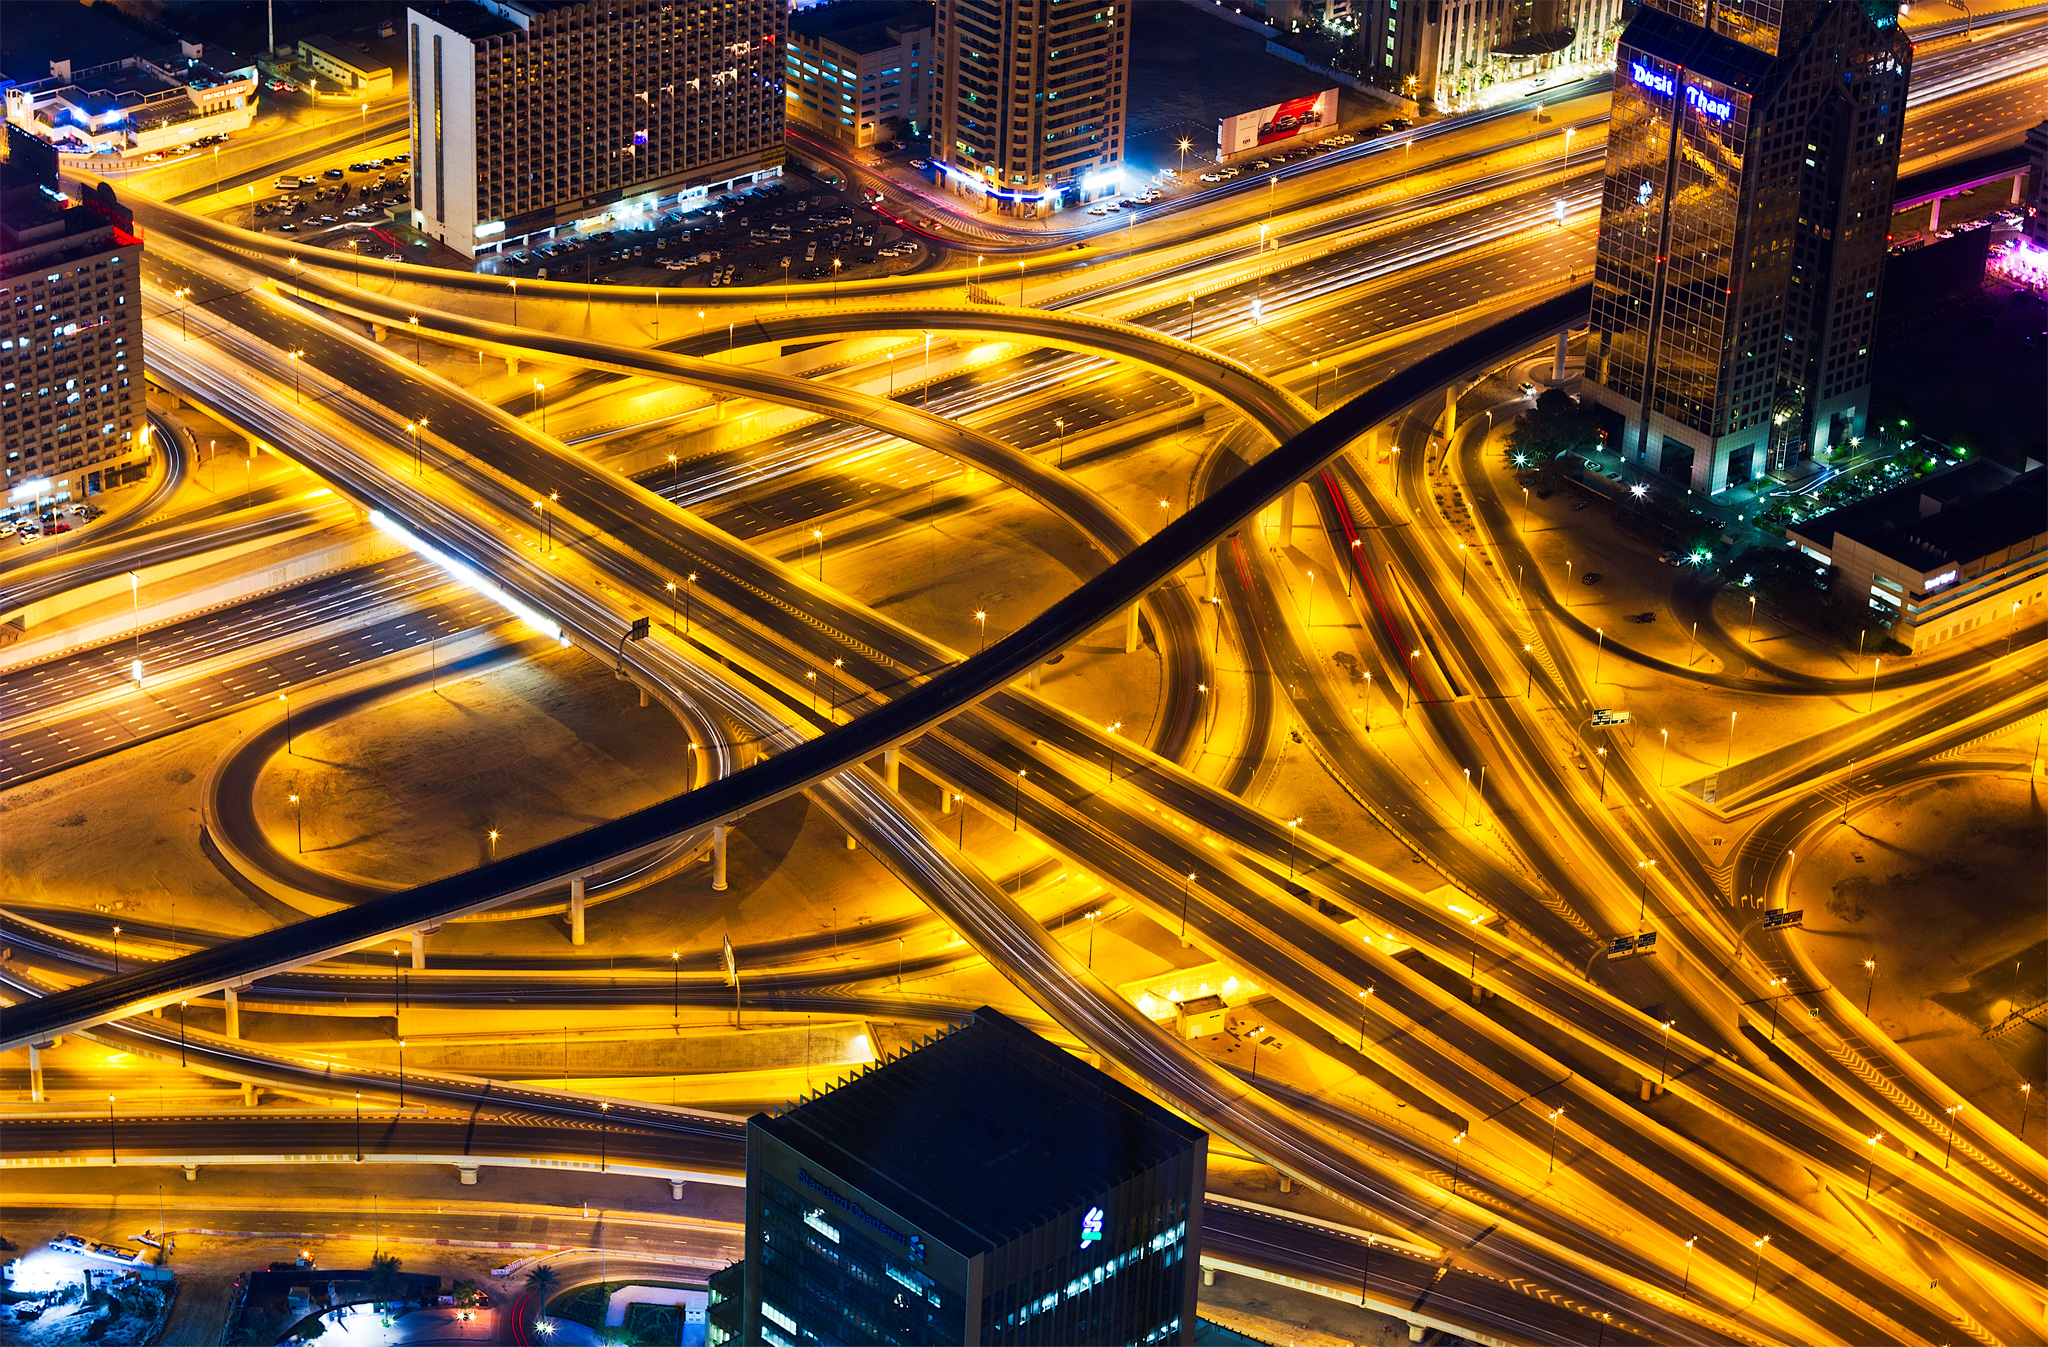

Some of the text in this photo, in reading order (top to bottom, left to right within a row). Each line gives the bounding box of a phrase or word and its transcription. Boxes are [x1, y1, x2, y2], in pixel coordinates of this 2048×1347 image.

[1633, 62, 1732, 121] Dusit Thani
[798, 1169, 906, 1247] Standard Chartered
